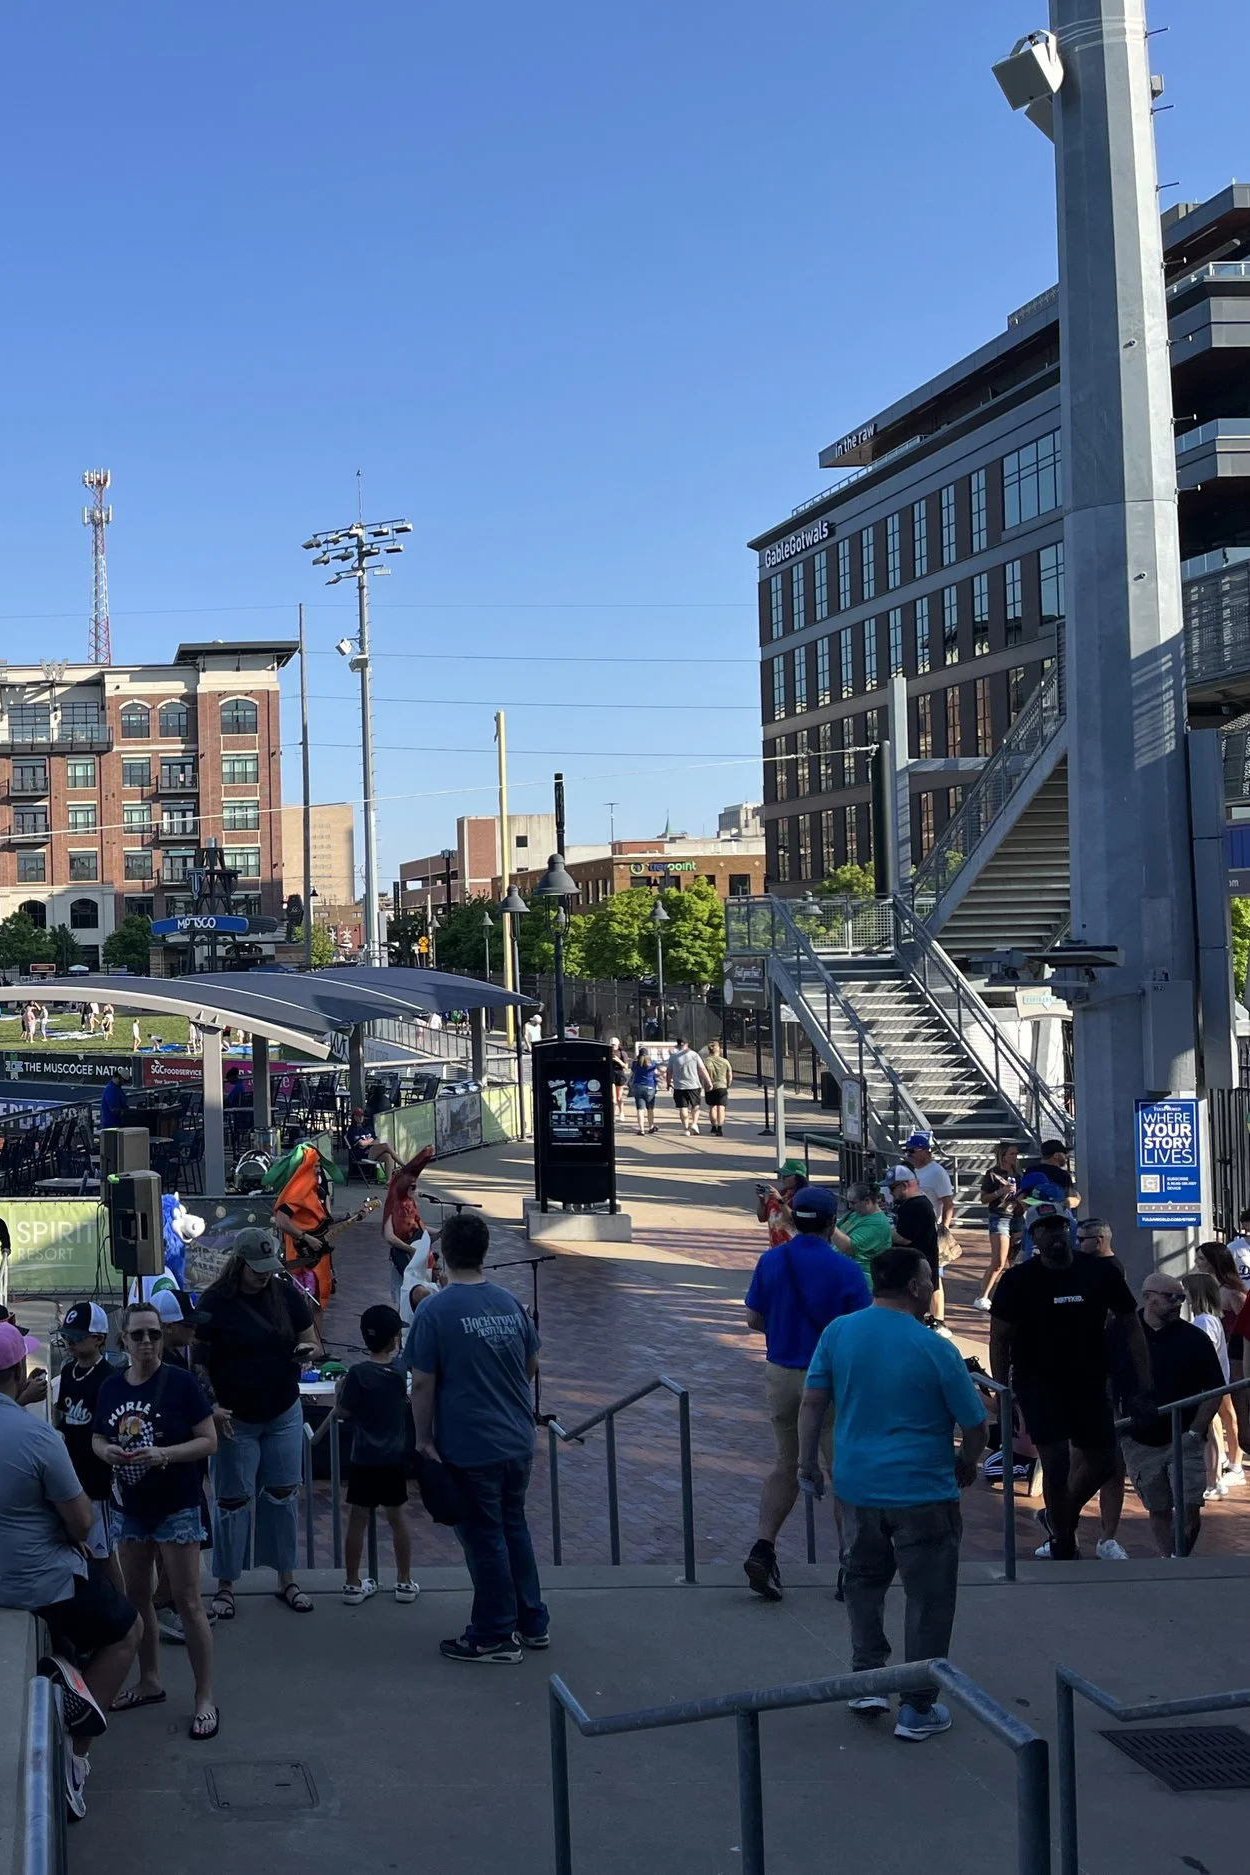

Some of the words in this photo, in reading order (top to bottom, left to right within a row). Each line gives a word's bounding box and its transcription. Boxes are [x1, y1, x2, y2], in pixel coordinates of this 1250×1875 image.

[835, 443, 843, 458] in
[844, 436, 857, 451] the
[858, 423, 875, 444] raw
[765, 520, 829, 568] GableGotwals
[24, 1062, 42, 1072] THE
[44, 1063, 93, 1076] MUSCOGEE
[1143, 1112, 1190, 1123] WHERE
[1143, 1123, 1192, 1137] YOUR
[1144, 1137, 1192, 1149] STORY
[1144, 1149, 1193, 1164] LIVES
[16, 1220, 96, 1244] SPIRIT
[18, 1247, 74, 1262] RESORT
